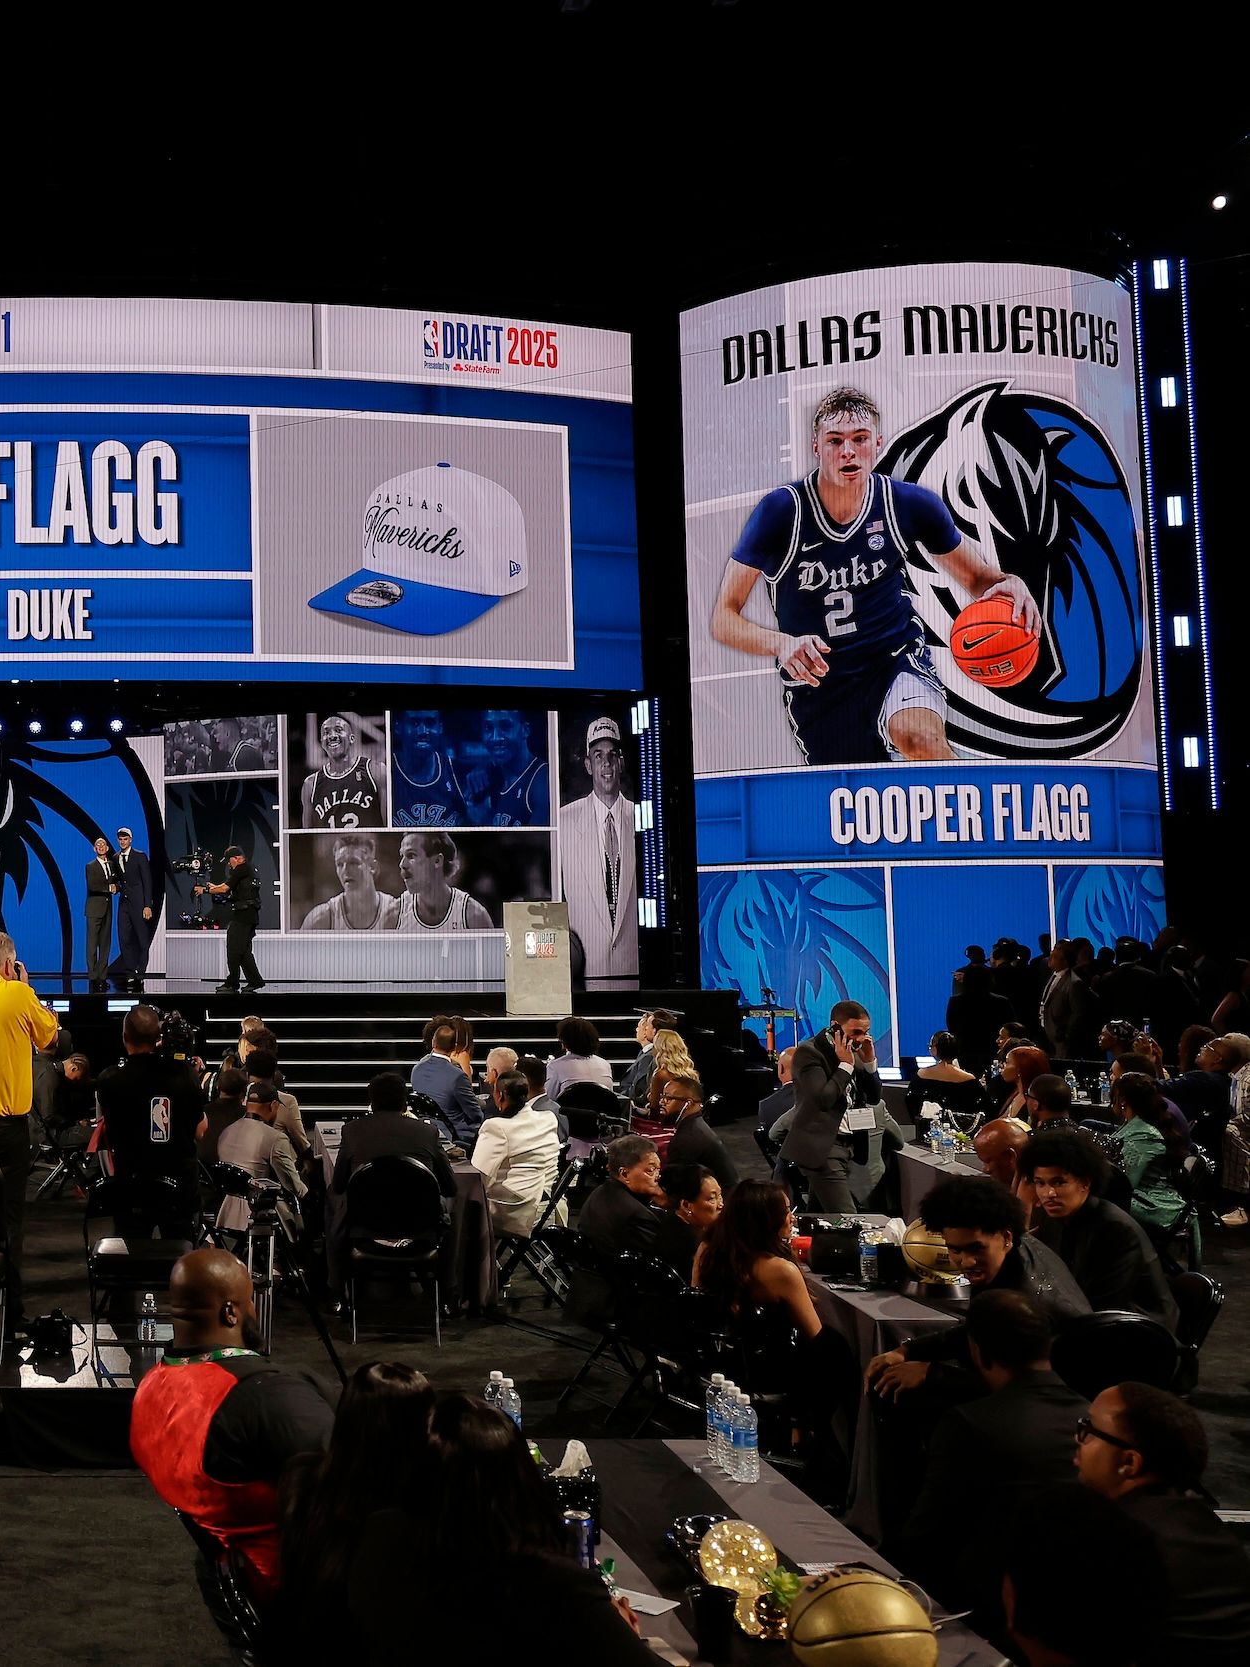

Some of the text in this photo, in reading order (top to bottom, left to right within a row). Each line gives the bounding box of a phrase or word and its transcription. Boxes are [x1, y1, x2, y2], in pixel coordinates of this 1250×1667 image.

[0, 311, 12, 353] 1
[442, 321, 558, 369] DRAFT 2025
[722, 303, 1120, 386] DALLAS MAVERICKS
[464, 364, 482, 373] State
[482, 366, 501, 375] Farm
[376, 493, 443, 513] DALLAS
[364, 505, 465, 559] Mavericks
[798, 555, 888, 591] Duke
[6, 589, 93, 642] DUKE
[823, 590, 858, 638] 2
[314, 788, 374, 820] DALLAS
[829, 783, 1090, 845] COOPER FLAGG
[536, 943, 555, 955] 2025
[537, 932, 556, 944] DRAFT
